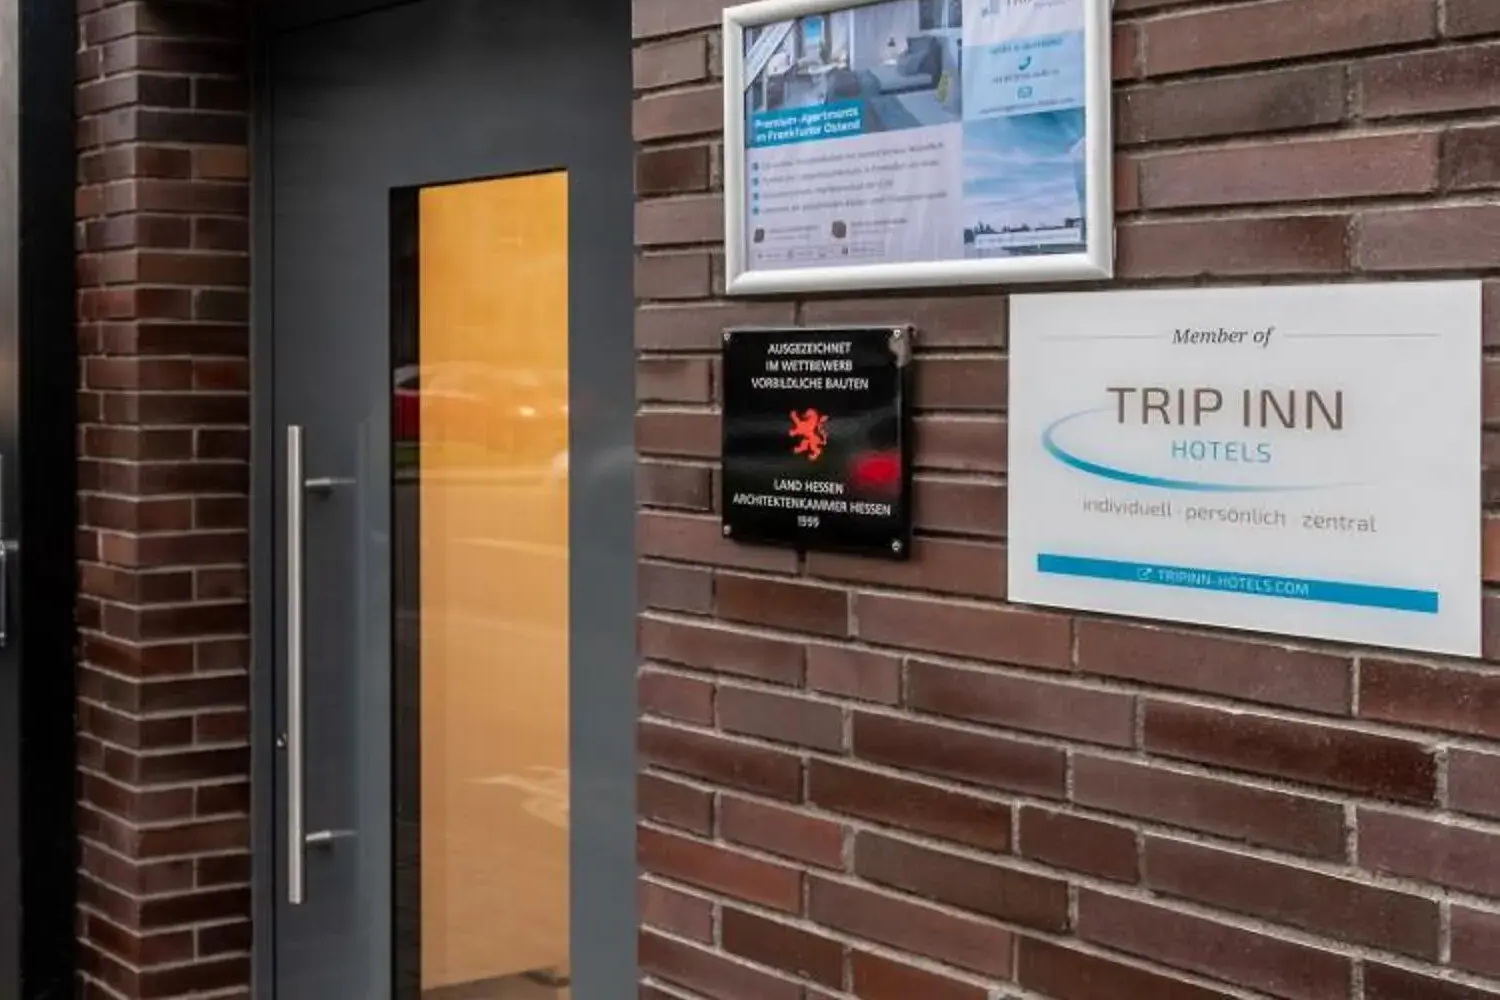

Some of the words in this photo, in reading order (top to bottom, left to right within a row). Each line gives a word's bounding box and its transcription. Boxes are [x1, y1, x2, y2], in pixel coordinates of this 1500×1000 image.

[1172, 327, 1248, 345] Member
[1252, 326, 1276, 347] of
[767, 341, 852, 355] AUSGEZEICHNET
[765, 359, 779, 372] IM
[781, 359, 853, 372] WETTBEWERB
[751, 377, 823, 389] VORBILDLICHE
[825, 377, 869, 390] BAUTEN
[1106, 387, 1223, 426] TRIP
[1243, 389, 1344, 431] INN
[1171, 440, 1272, 464] HOTELS
[773, 479, 801, 491] LAND
[804, 481, 844, 494] HESSEN
[732, 492, 847, 512] ARCHITEKTENKAMMER
[850, 501, 891, 516] HESSEN
[1083, 498, 1172, 518] individuell
[1185, 502, 1286, 527] persönlich
[1302, 515, 1377, 533] zentral
[1158, 569, 1309, 596] TRIPINN-HOTELS.COM
